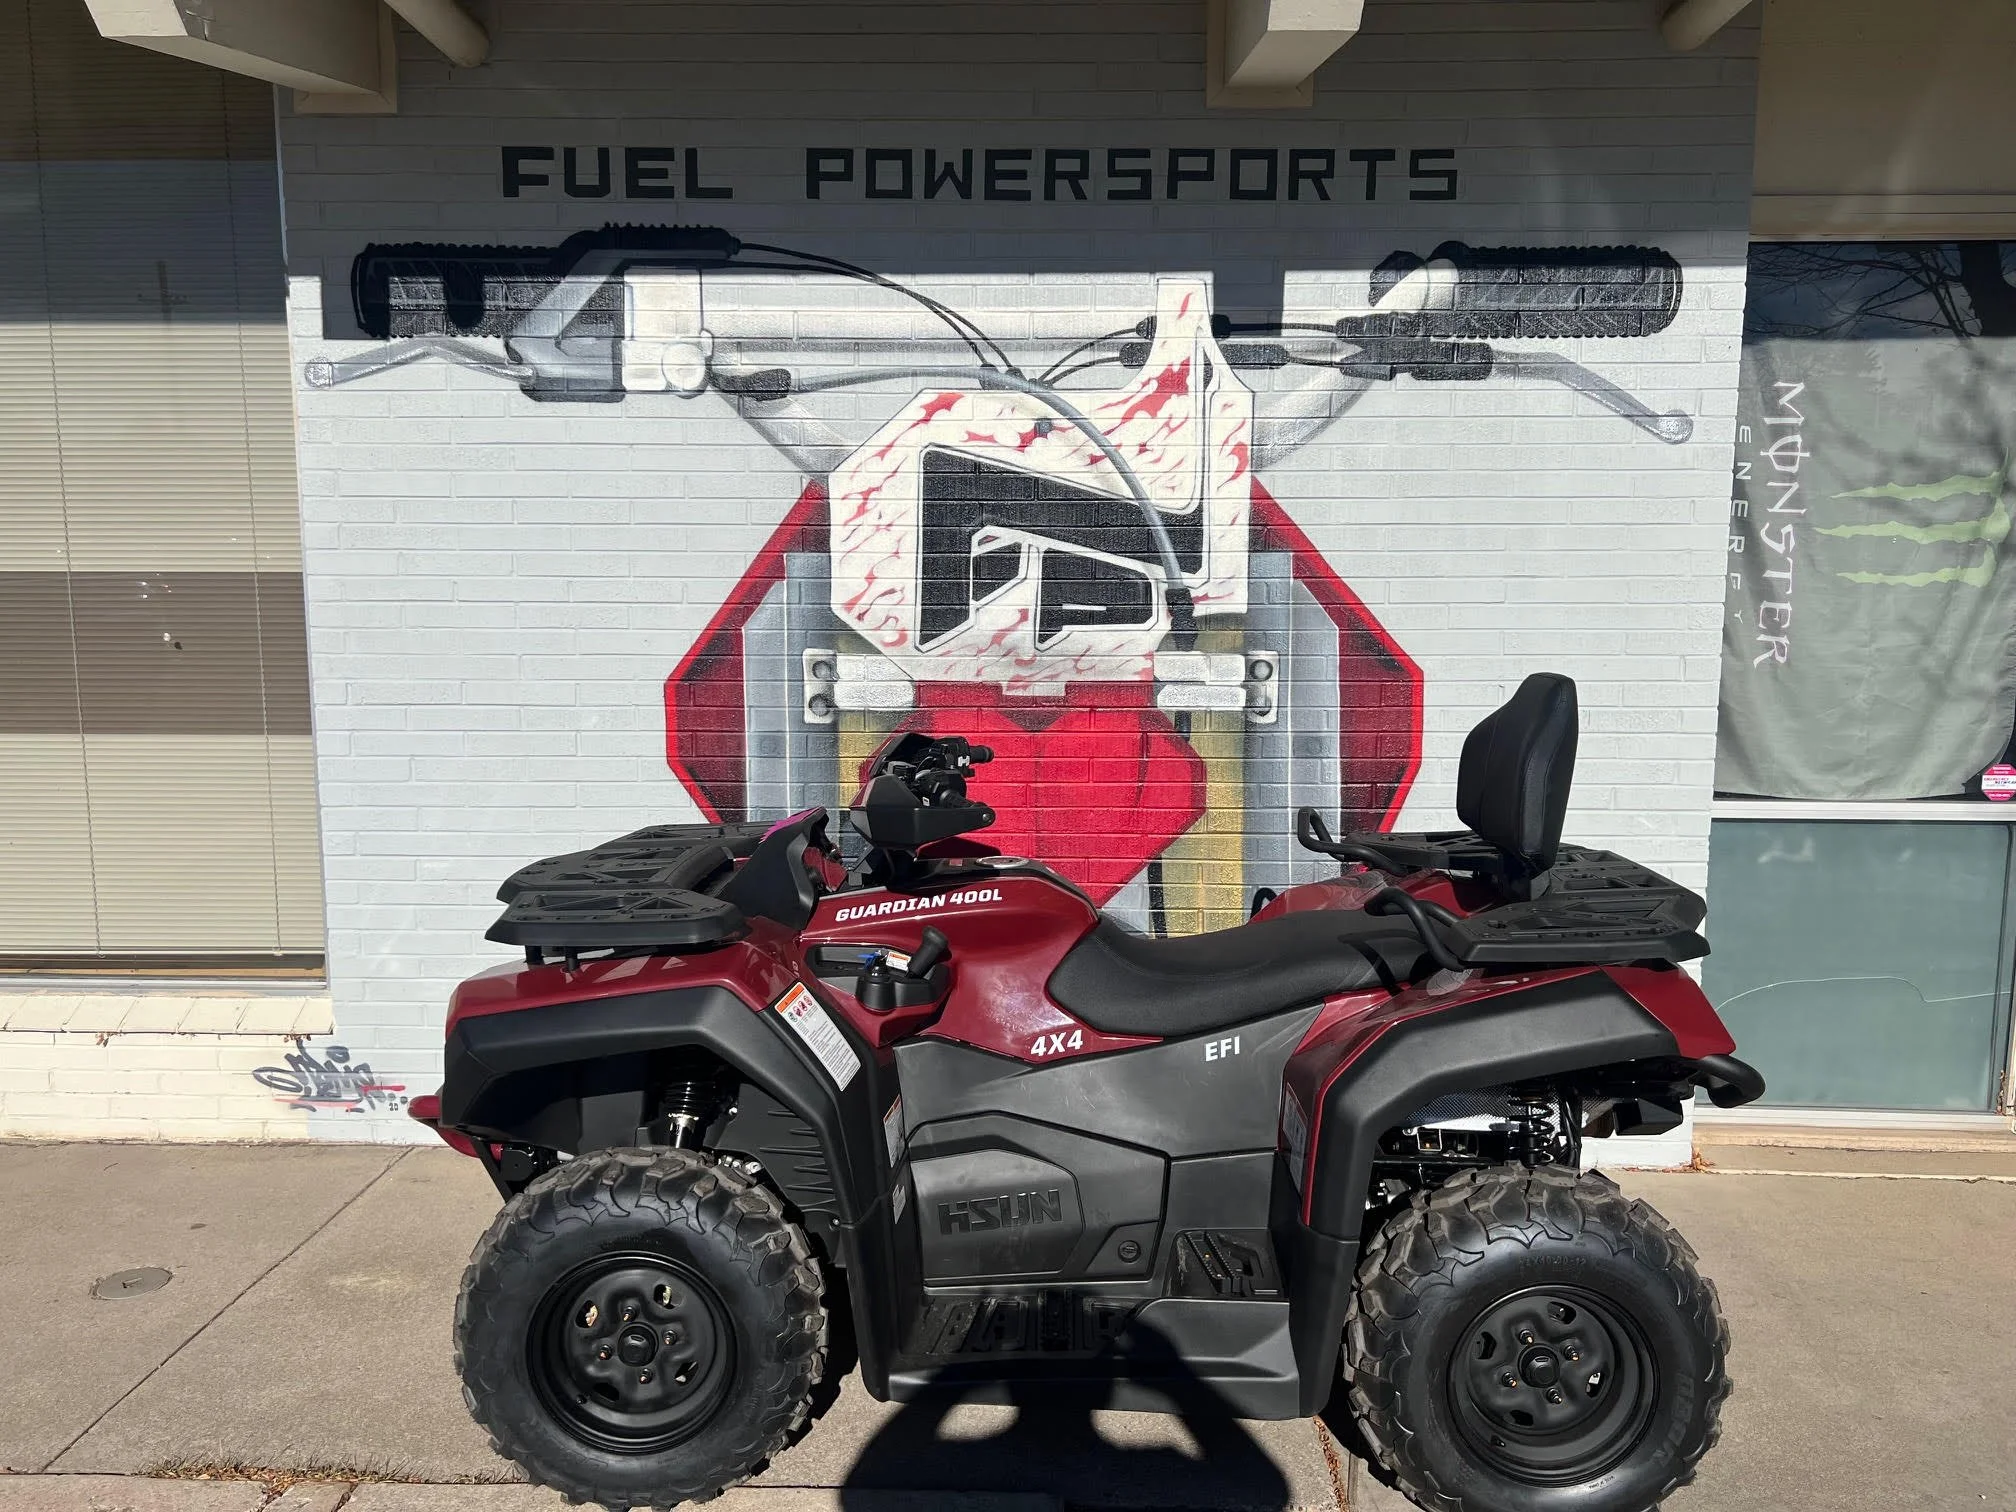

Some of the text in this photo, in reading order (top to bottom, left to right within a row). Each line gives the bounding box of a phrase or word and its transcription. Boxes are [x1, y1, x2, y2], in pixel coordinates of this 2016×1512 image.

[501, 146, 1458, 201] FUEL POWERSPORTS
[835, 888, 1003, 922] GUARDIAN 400L
[1030, 1029, 1084, 1057] 4X4
[1204, 1035, 1241, 1062] EFI
[937, 1188, 1063, 1236] HSUN
